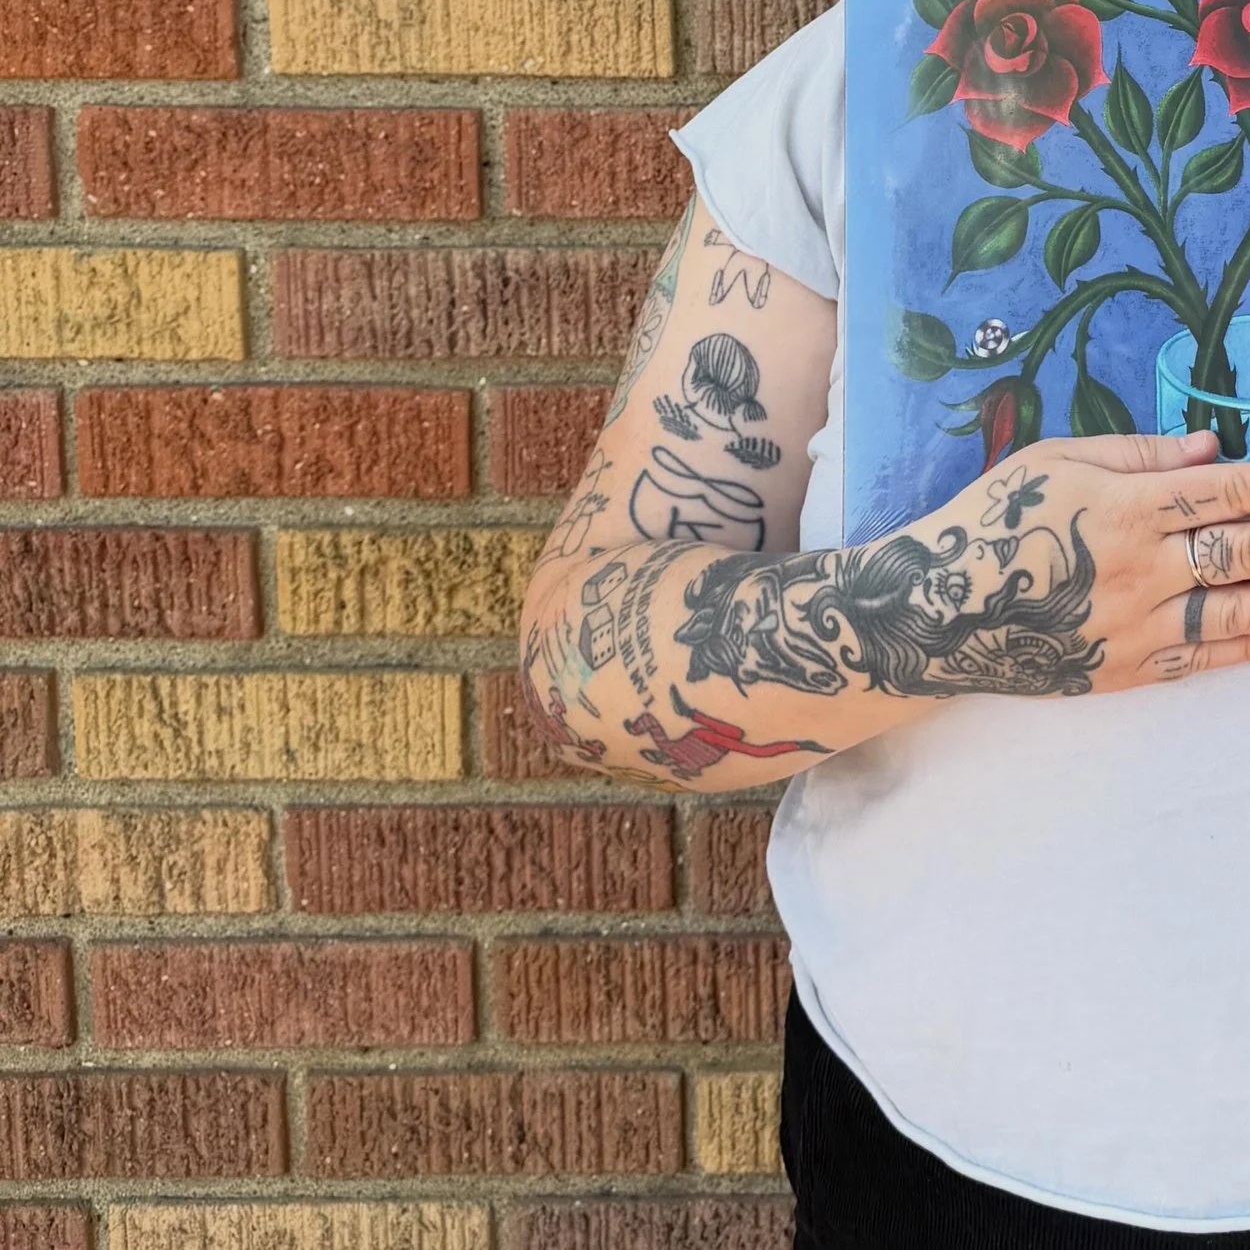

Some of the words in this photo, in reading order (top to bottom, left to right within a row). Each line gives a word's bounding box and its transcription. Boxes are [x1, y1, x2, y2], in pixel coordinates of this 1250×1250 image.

[617, 582, 641, 636] TRICK
[635, 589, 653, 617] ON
[618, 631, 636, 670] THE
[635, 616, 658, 677] PLAYED
[630, 667, 648, 695] AM
